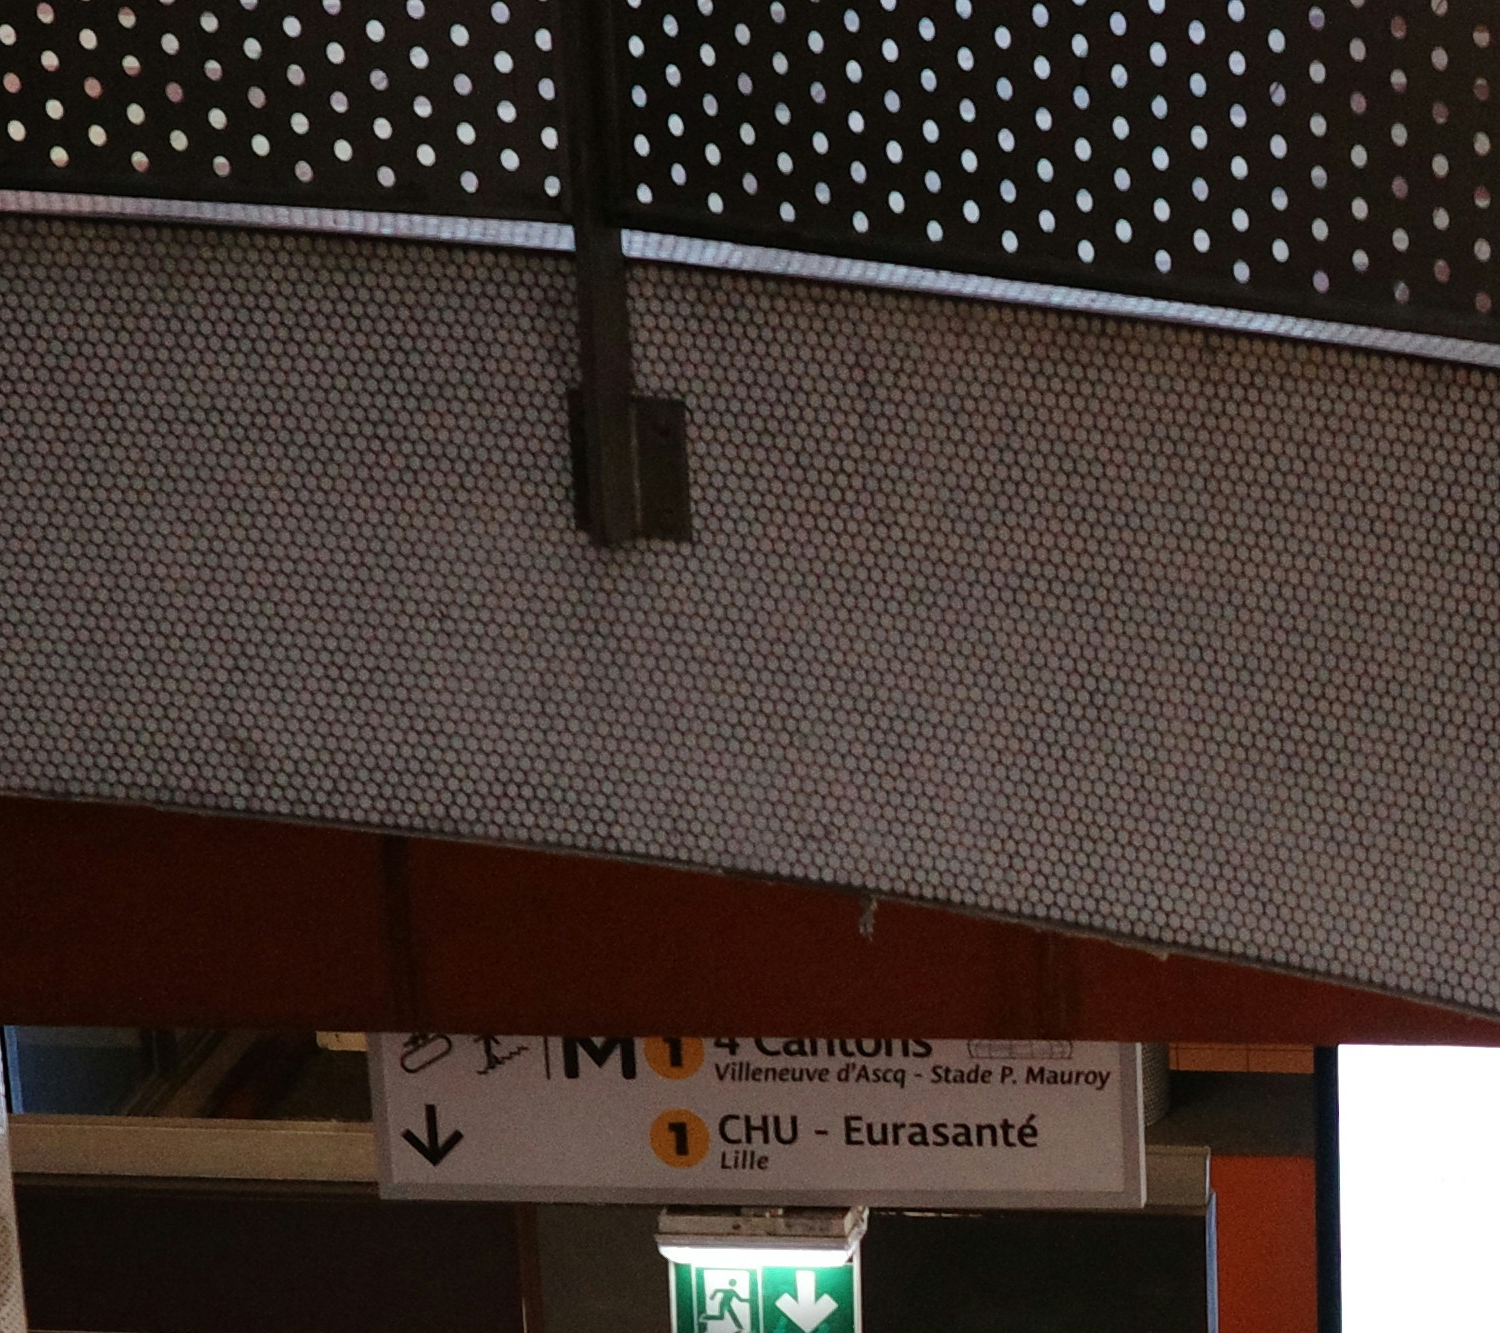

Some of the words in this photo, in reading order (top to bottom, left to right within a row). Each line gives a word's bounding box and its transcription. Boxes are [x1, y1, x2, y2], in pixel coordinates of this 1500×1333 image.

[563, 1037, 637, 1080] M
[754, 1037, 933, 1058] Cantons
[715, 1062, 829, 1083] Villeneuve
[837, 1063, 906, 1089] d'Ascq
[930, 1064, 993, 1085] Stade
[1000, 1065, 1017, 1085] P.
[1025, 1066, 1112, 1091] Mauroy
[667, 1121, 690, 1156] 1
[718, 1113, 799, 1145] CHU
[843, 1113, 1039, 1148] Eurasanté
[720, 1150, 769, 1170] Lille
